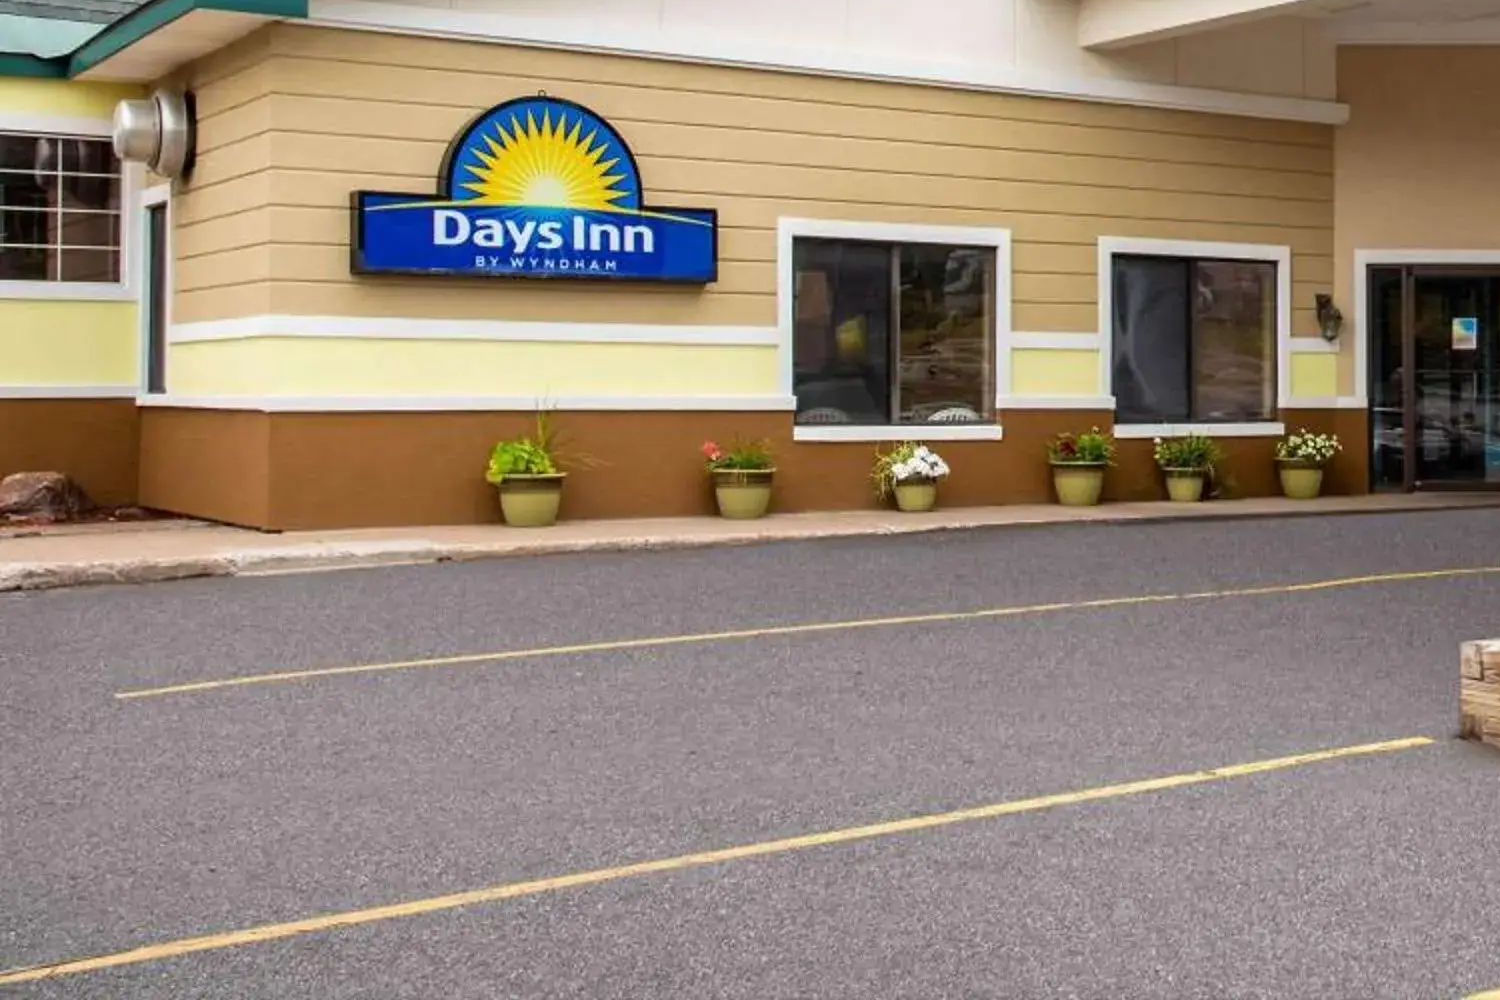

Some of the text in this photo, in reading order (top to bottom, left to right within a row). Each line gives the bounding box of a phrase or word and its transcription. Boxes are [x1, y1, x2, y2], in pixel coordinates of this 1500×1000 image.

[433, 209, 655, 254] Days Inn
[475, 255, 618, 271] BY WYNDHAM
